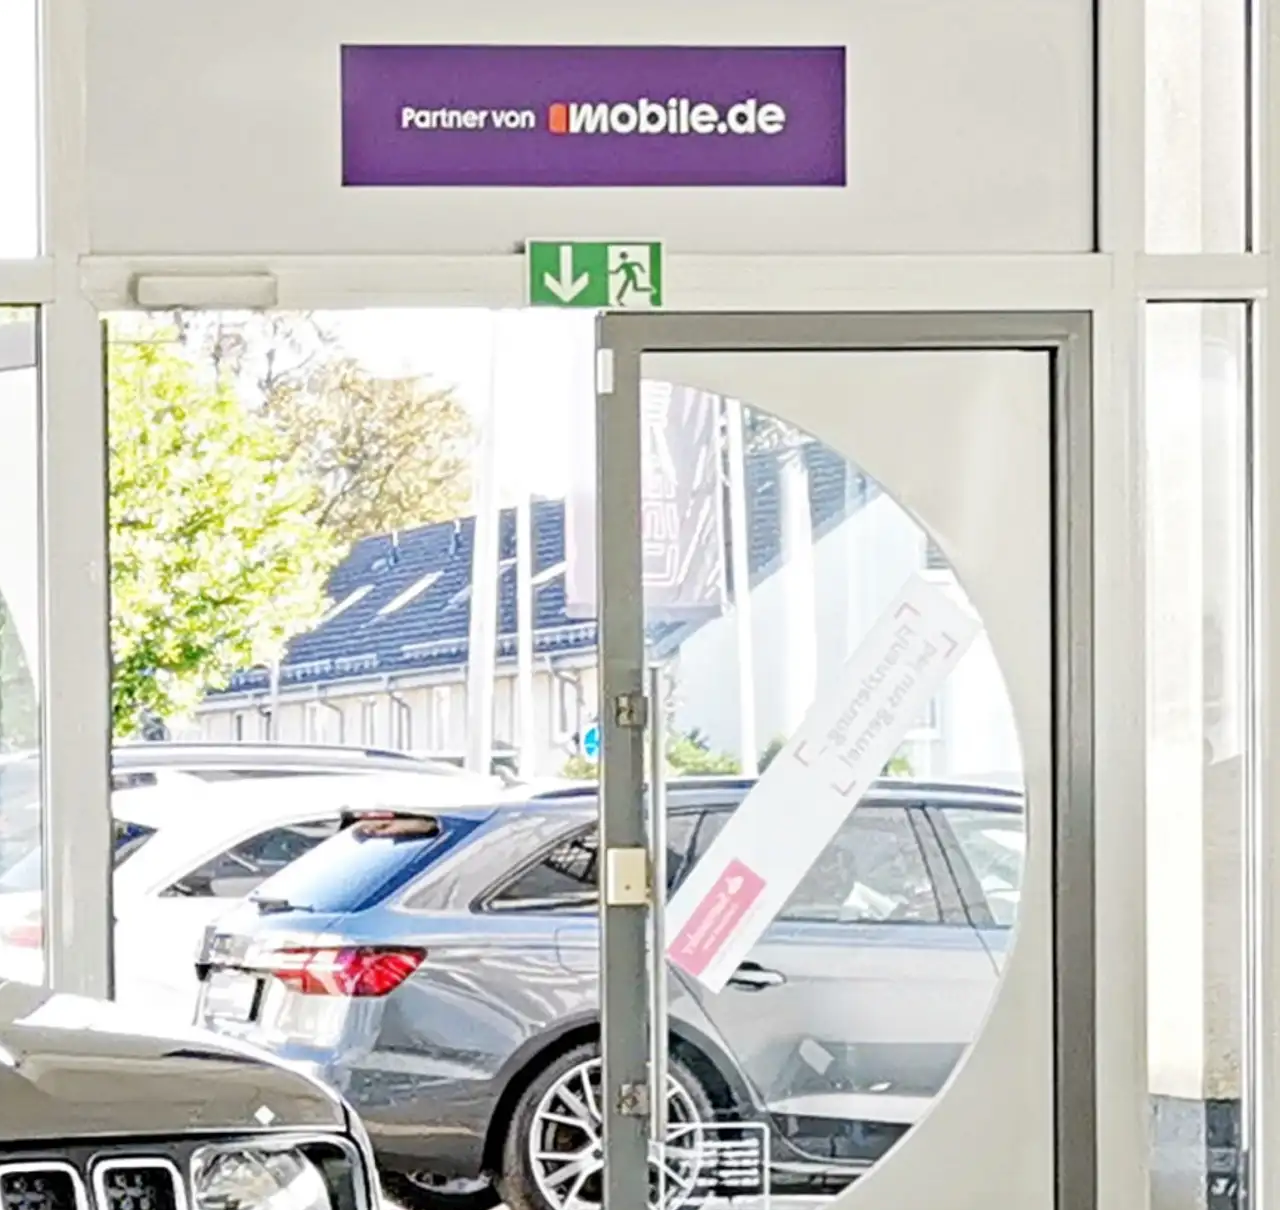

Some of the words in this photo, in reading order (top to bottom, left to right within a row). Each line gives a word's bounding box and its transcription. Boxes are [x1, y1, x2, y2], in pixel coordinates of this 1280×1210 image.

[401, 106, 486, 129] Partner
[492, 108, 536, 129] von
[569, 97, 786, 135] mobile.de
